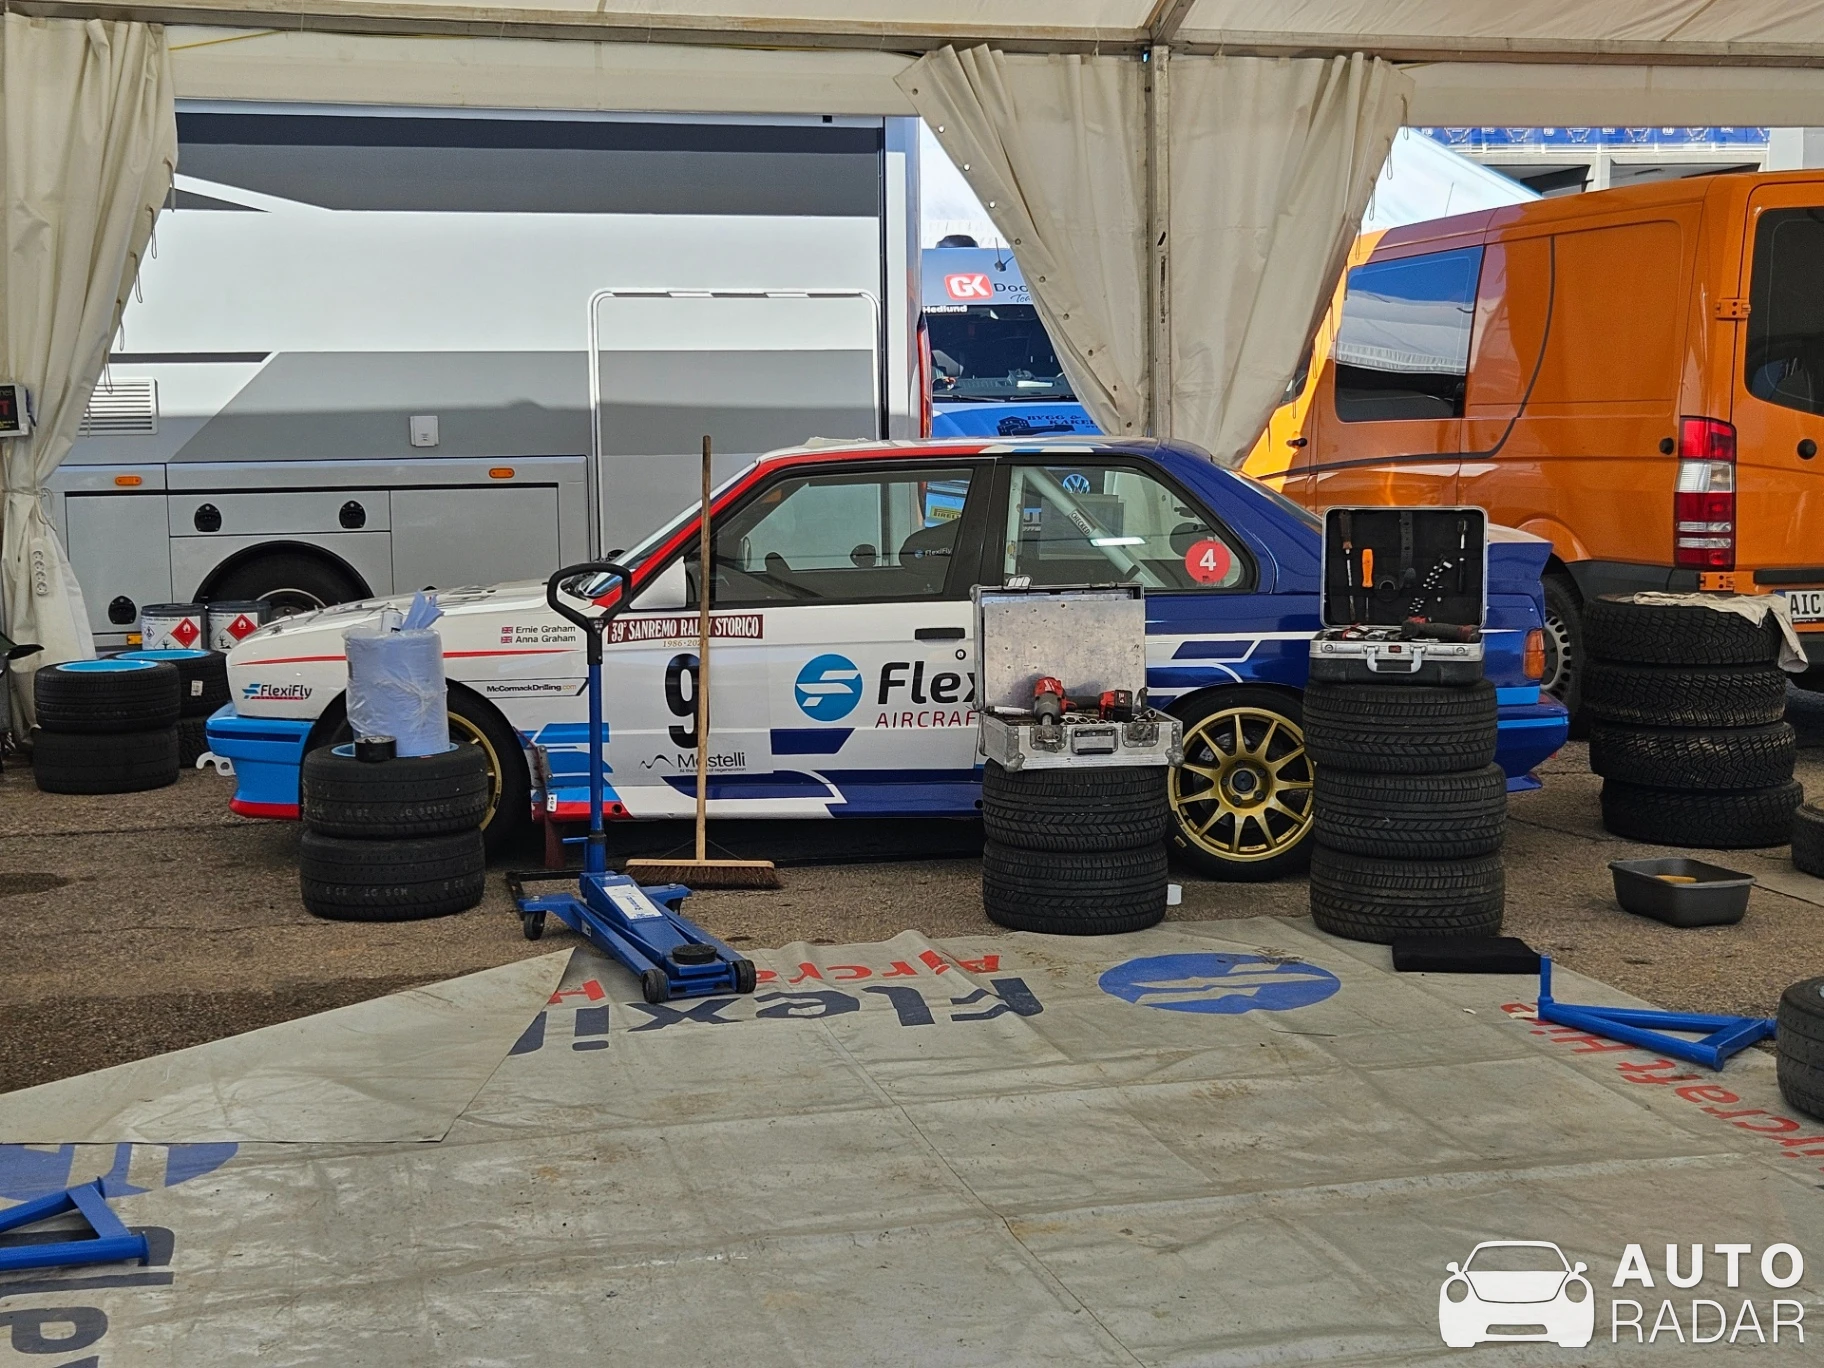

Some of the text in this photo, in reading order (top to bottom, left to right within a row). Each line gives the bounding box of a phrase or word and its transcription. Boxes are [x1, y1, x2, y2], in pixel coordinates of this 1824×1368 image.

[949, 276, 1029, 297] GK Doo
[922, 305, 968, 314] Hedlund
[1070, 511, 1092, 536] CHECKED
[1199, 548, 1217, 572] 4
[1790, 594, 1822, 615] AIC
[515, 625, 576, 634] Ernie Graham
[515, 635, 576, 643] Anna Graham
[628, 619, 677, 641] SANREMO
[680, 618, 713, 637] RALY
[714, 616, 760, 637] STORICO
[260, 684, 313, 700] FlexiFly
[486, 684, 577, 692] McCormackDrilling.com
[664, 652, 710, 749] 9
[875, 711, 978, 729] AIRCRAF
[677, 752, 746, 768] Mstelli
[755, 949, 1000, 985] Aircr
[1609, 1059, 1824, 1172] ircraft
